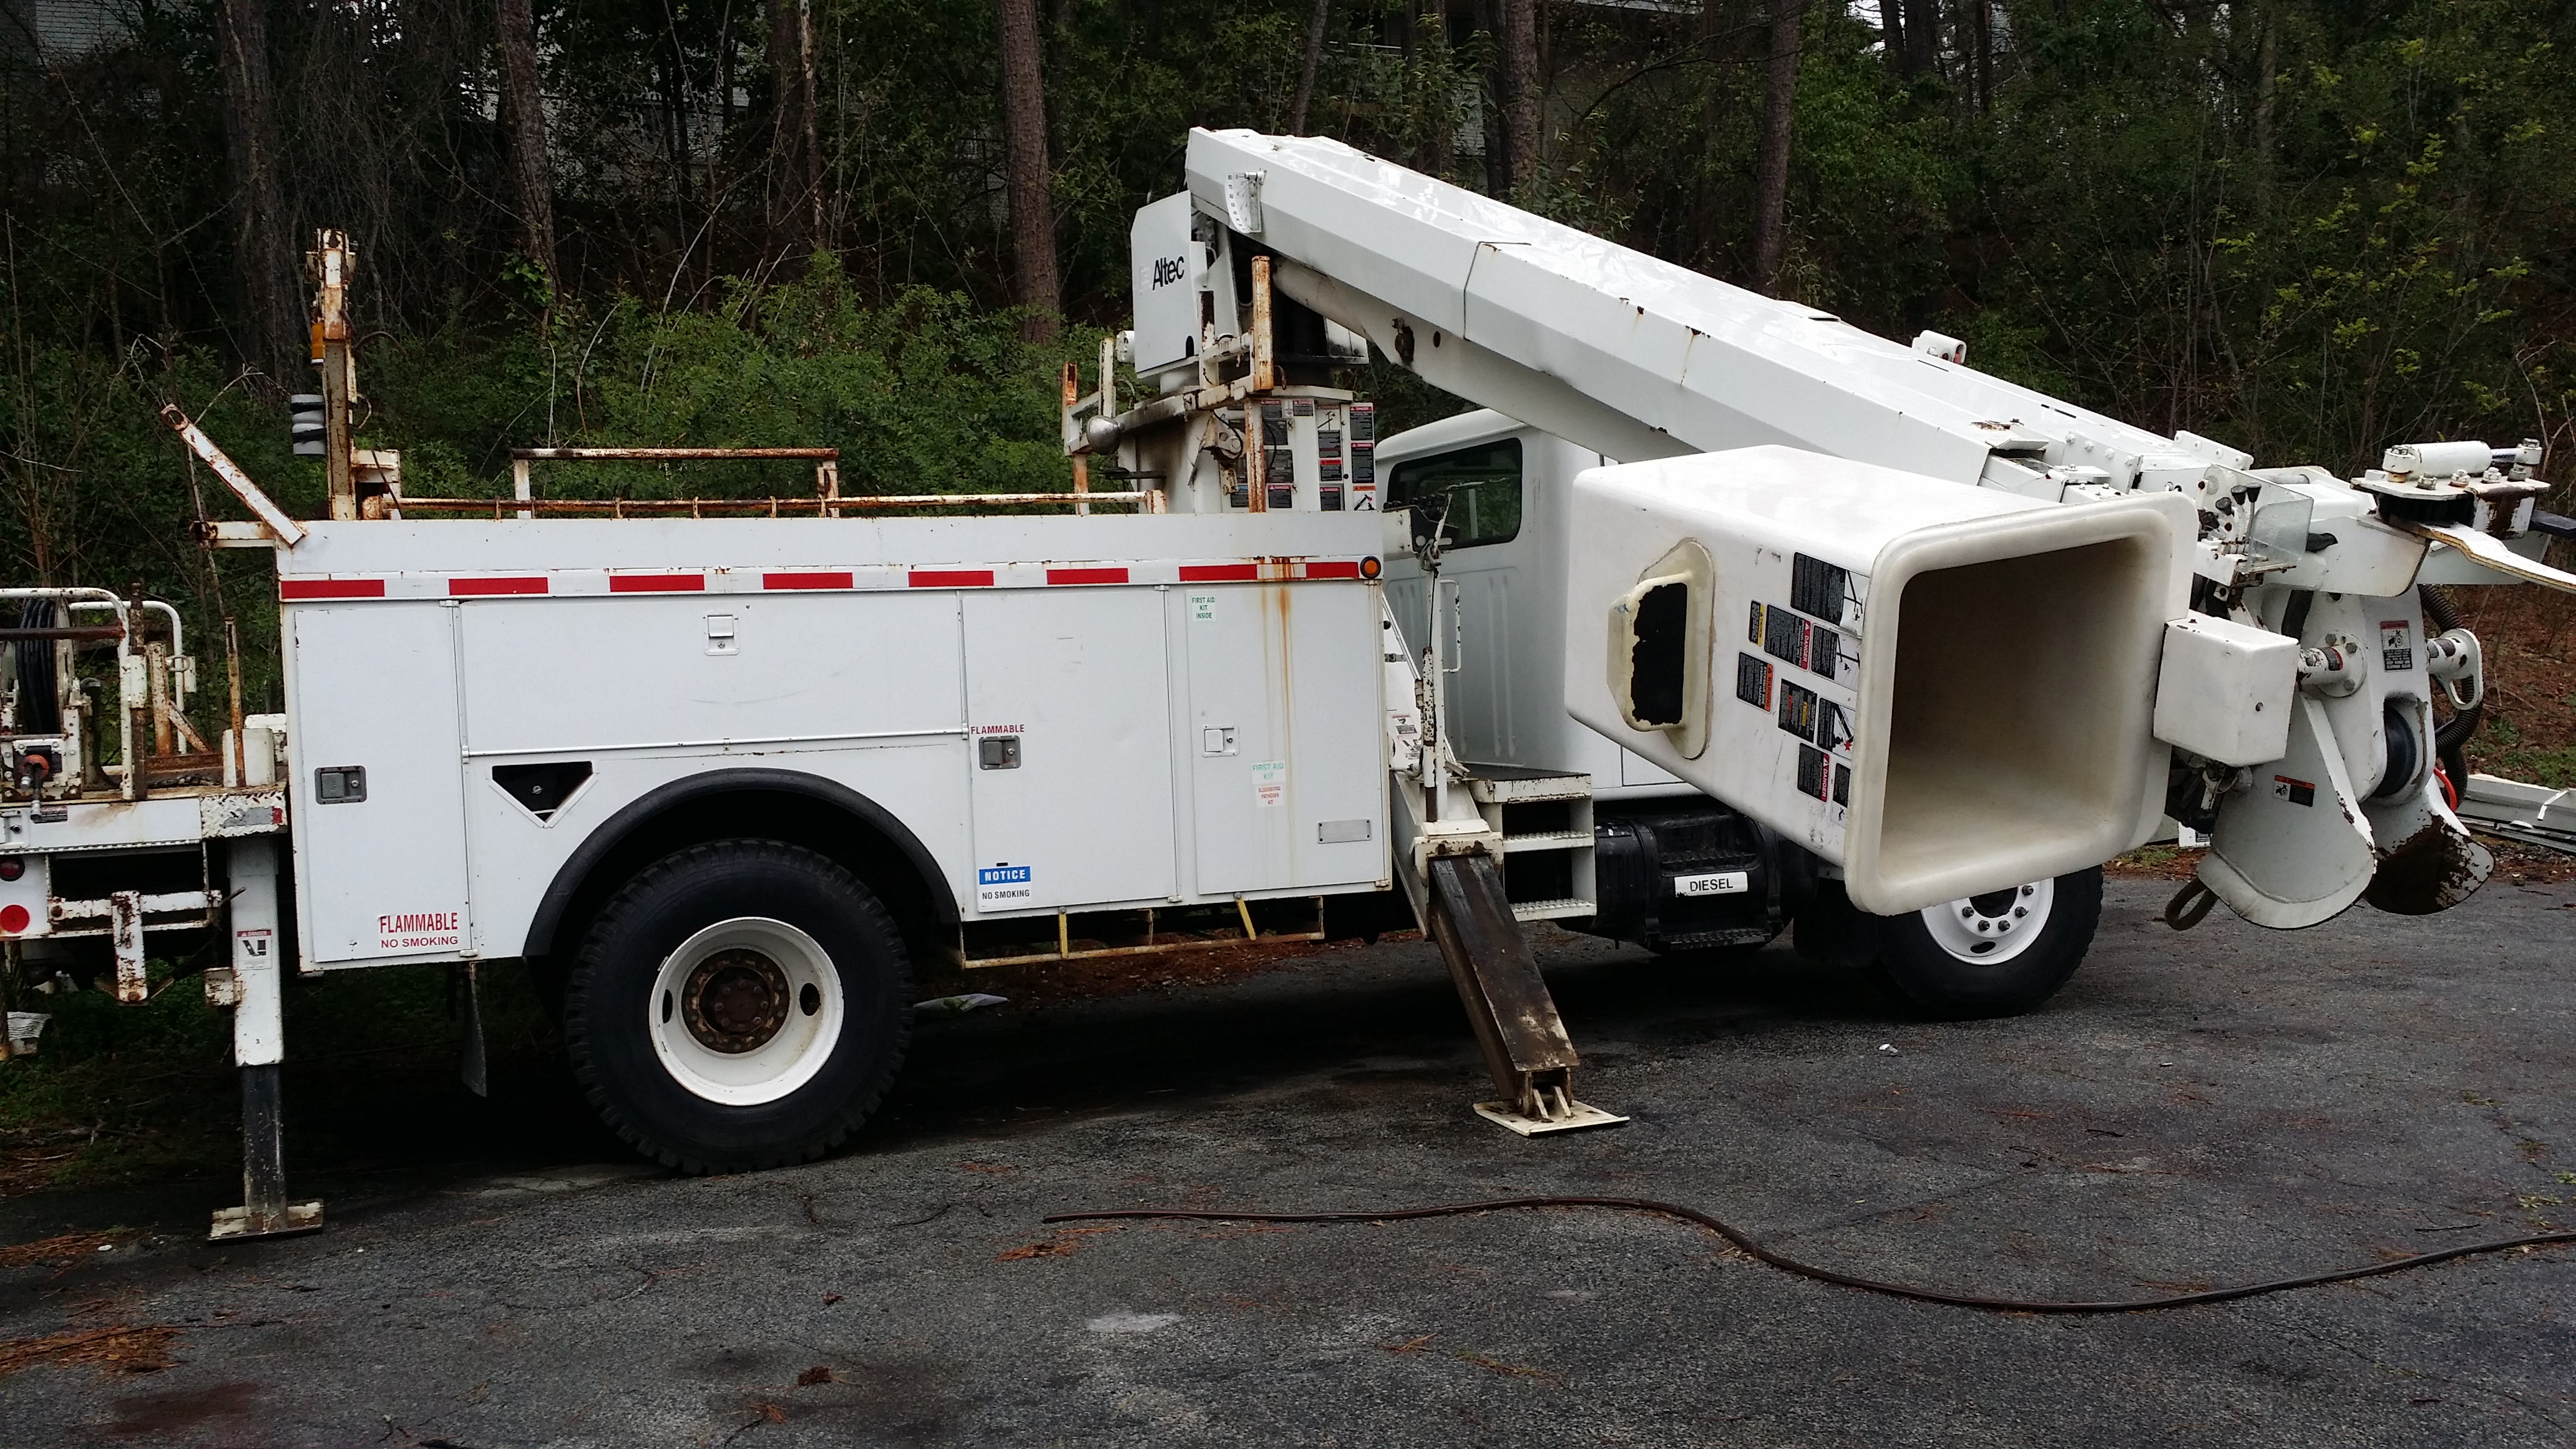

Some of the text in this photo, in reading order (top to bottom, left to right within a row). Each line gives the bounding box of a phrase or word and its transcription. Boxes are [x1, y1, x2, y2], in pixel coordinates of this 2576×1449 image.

[1152, 256, 1185, 291] Altec
[970, 724, 1025, 734] FLAMMABLE
[1252, 763, 1271, 771] FIRST
[985, 869, 1026, 881] NOTICE
[1690, 878, 1734, 892] DIESEL
[995, 889, 1030, 899] SMOKING
[379, 912, 458, 934] FLAMMABLE
[381, 936, 458, 948] NO SMOKING
